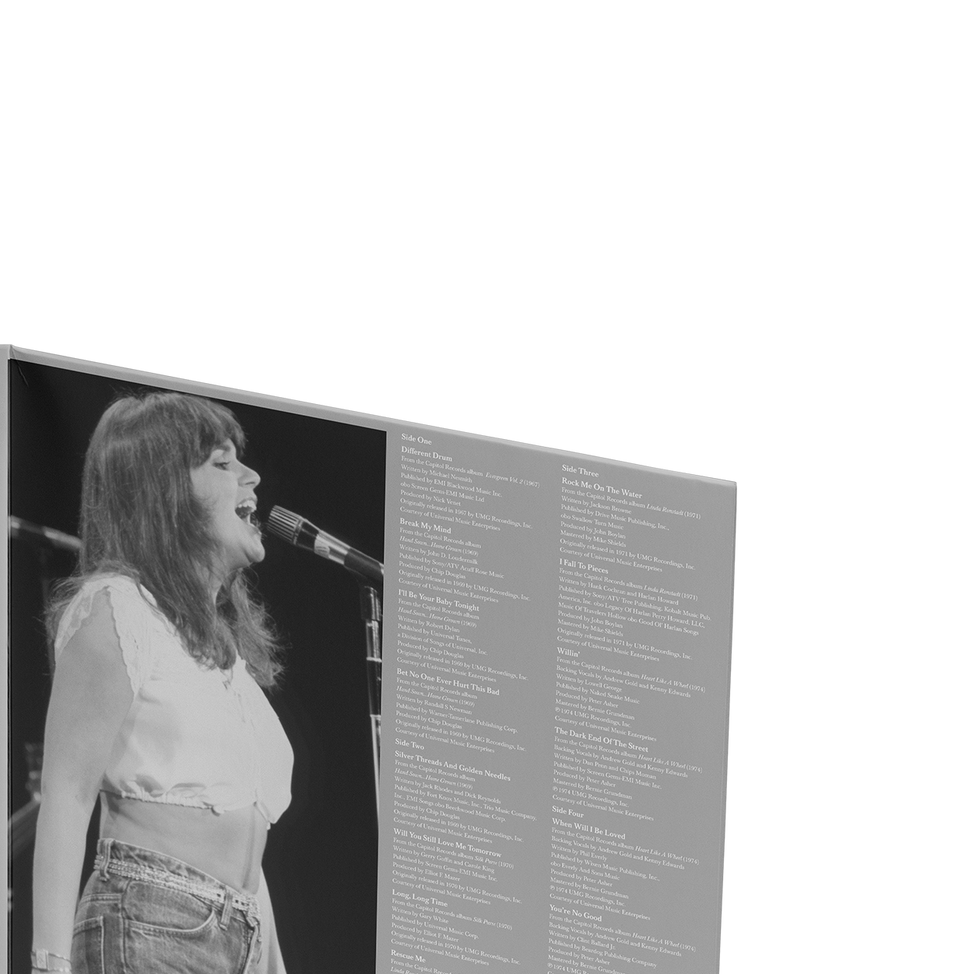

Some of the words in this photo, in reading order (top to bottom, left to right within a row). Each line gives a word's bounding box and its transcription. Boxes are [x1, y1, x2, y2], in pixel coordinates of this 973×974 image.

[401, 432, 416, 442] Side
[417, 436, 432, 445] One
[401, 445, 431, 458] Different
[432, 451, 452, 462] Drum
[401, 464, 421, 473] Written
[429, 469, 449, 478] Michael
[561, 464, 577, 473] Side
[578, 467, 599, 477] Three
[400, 489, 425, 499] Produced
[562, 477, 579, 487] Rock
[580, 480, 592, 489] Me
[593, 483, 605, 492] On
[606, 485, 620, 494] The
[621, 488, 642, 499] Water
[561, 495, 581, 504] Written
[589, 501, 610, 510] Jackson
[611, 505, 631, 514] Browne
[400, 517, 419, 528] Break
[421, 521, 432, 532] My
[433, 524, 451, 534] Mind
[564, 559, 576, 568] Fall
[577, 561, 586, 570] To
[587, 563, 609, 574] Pieces
[408, 590, 417, 599] Be
[419, 592, 435, 602] Your
[436, 596, 452, 608] Baby
[454, 600, 479, 612] Tonight
[398, 615, 417, 624] Written
[426, 621, 443, 629] Robert
[444, 624, 460, 633] Dylan
[396, 667, 408, 676] Bet
[409, 670, 419, 679] No
[420, 673, 435, 682] One
[436, 676, 452, 685] Ever
[453, 679, 469, 689] Hurt
[470, 683, 486, 692] This
[486, 686, 500, 696] Bad
[555, 690, 580, 700] Produced
[603, 700, 618, 708] Asher
[395, 737, 409, 747] Side
[410, 741, 425, 750] Two
[554, 726, 568, 735] The
[569, 729, 587, 739] Dark
[588, 733, 602, 743] End
[602, 736, 613, 745] Of
[613, 738, 627, 748] The
[628, 742, 648, 753] Street
[394, 750, 414, 760] Silver
[415, 754, 442, 766] Threads
[443, 761, 457, 770] And
[458, 764, 483, 775] Golden
[484, 769, 511, 781] Needles
[551, 805, 567, 814] Side
[568, 808, 584, 818] Four
[552, 817, 572, 828] When
[574, 822, 589, 832] Will
[594, 827, 603, 835] Be
[604, 829, 626, 840] Loved
[393, 827, 408, 837] Will
[409, 831, 422, 840] You
[422, 834, 436, 843] Still
[437, 837, 454, 847] Love
[455, 841, 466, 850] Me
[467, 844, 502, 858] Tomorrow
[412, 893, 430, 904] Long
[430, 897, 448, 907] Time
[391, 905, 411, 915] Written
[419, 912, 432, 921] Gary
[433, 915, 448, 923] White
[572, 909, 582, 917] No
[583, 911, 602, 922] Good
[391, 949, 414, 960] Rescue
[415, 954, 426, 963] Me
